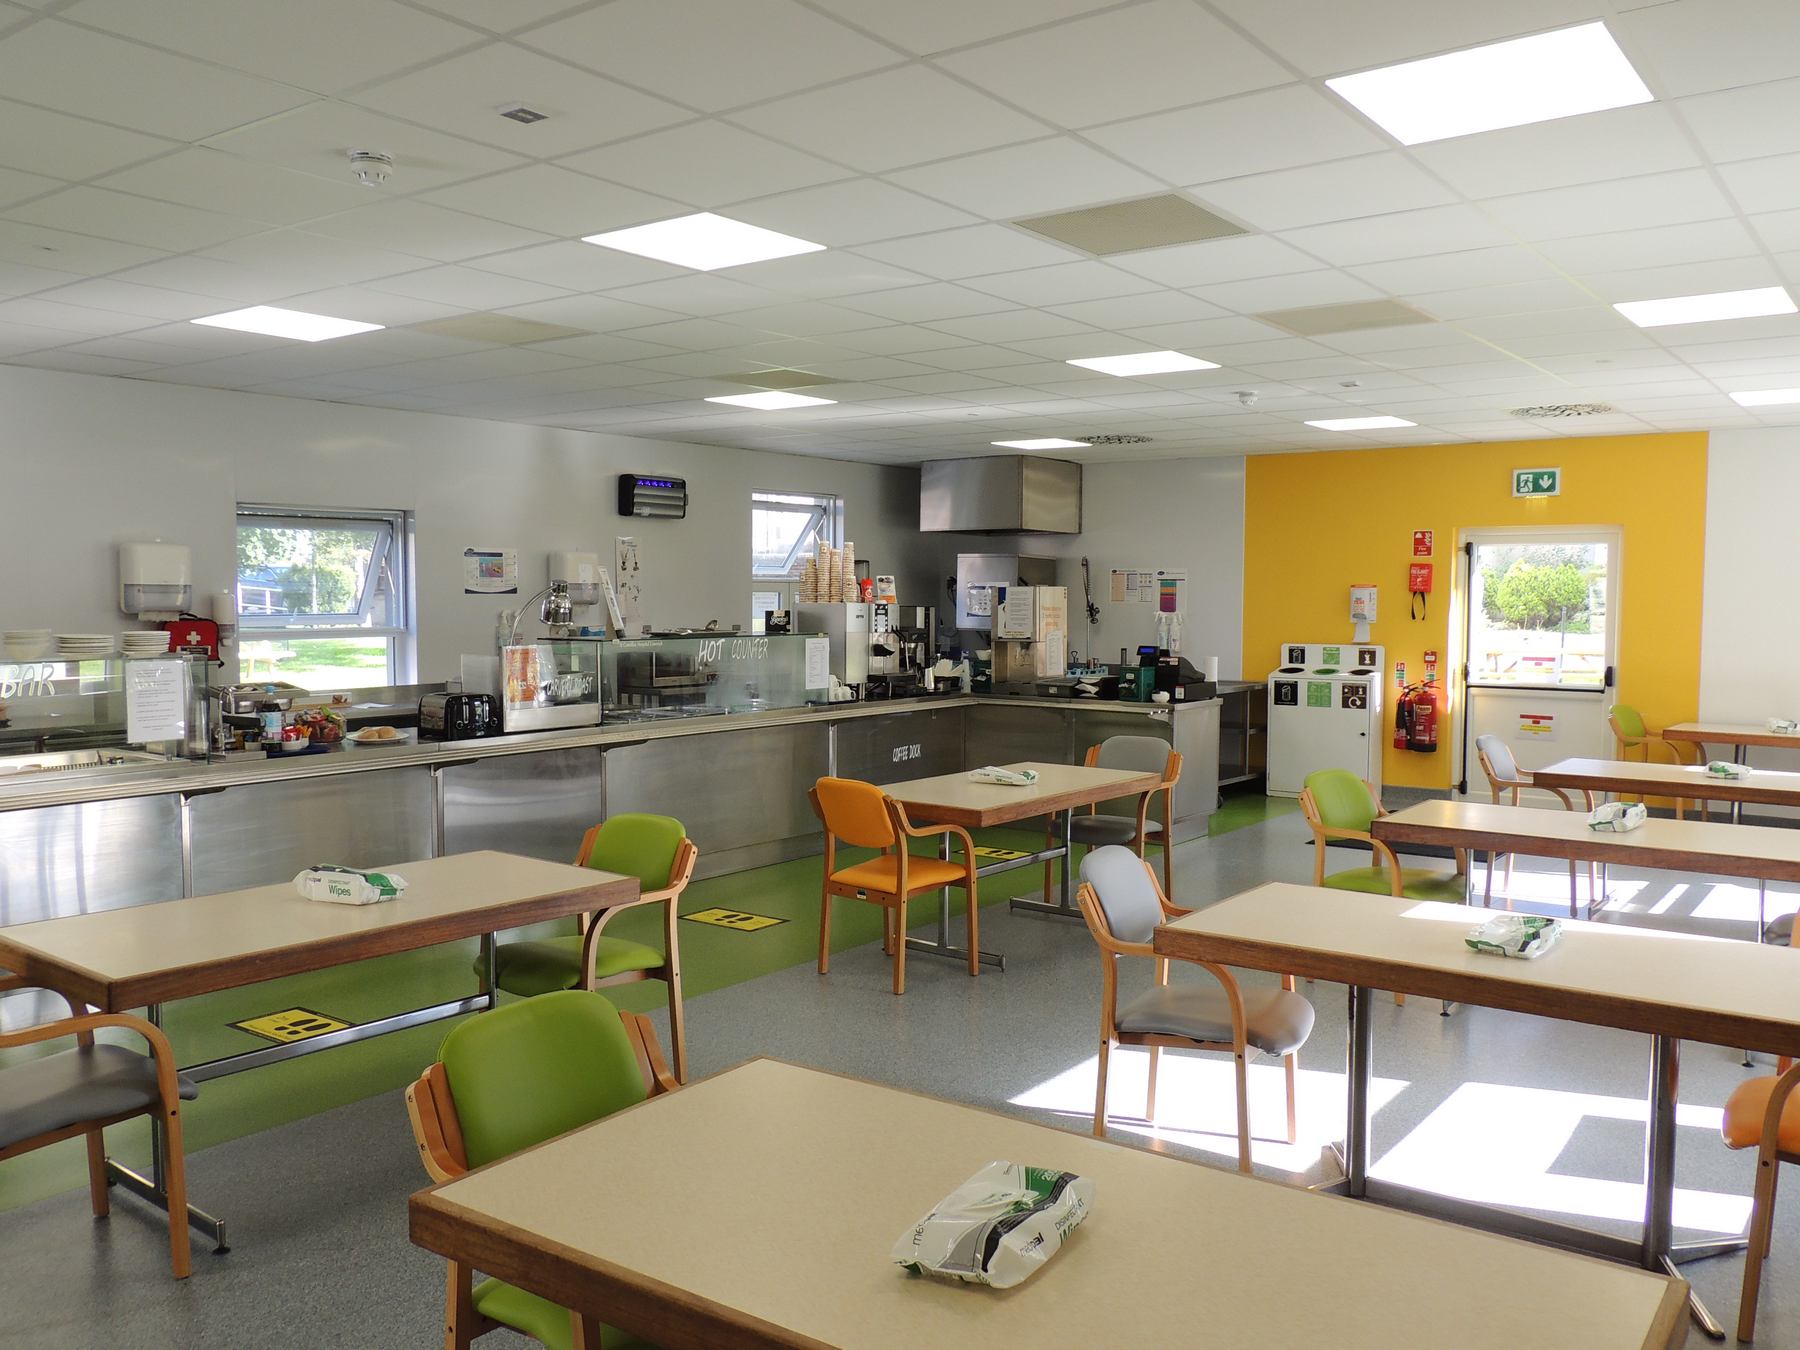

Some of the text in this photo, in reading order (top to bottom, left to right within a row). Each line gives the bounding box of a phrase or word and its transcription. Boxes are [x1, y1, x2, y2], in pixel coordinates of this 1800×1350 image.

[698, 638, 769, 662] HOT COUNTER
[0, 662, 56, 699] BAR
[892, 743, 921, 762] COFFEE DOCK
[328, 884, 352, 896] Wipes
